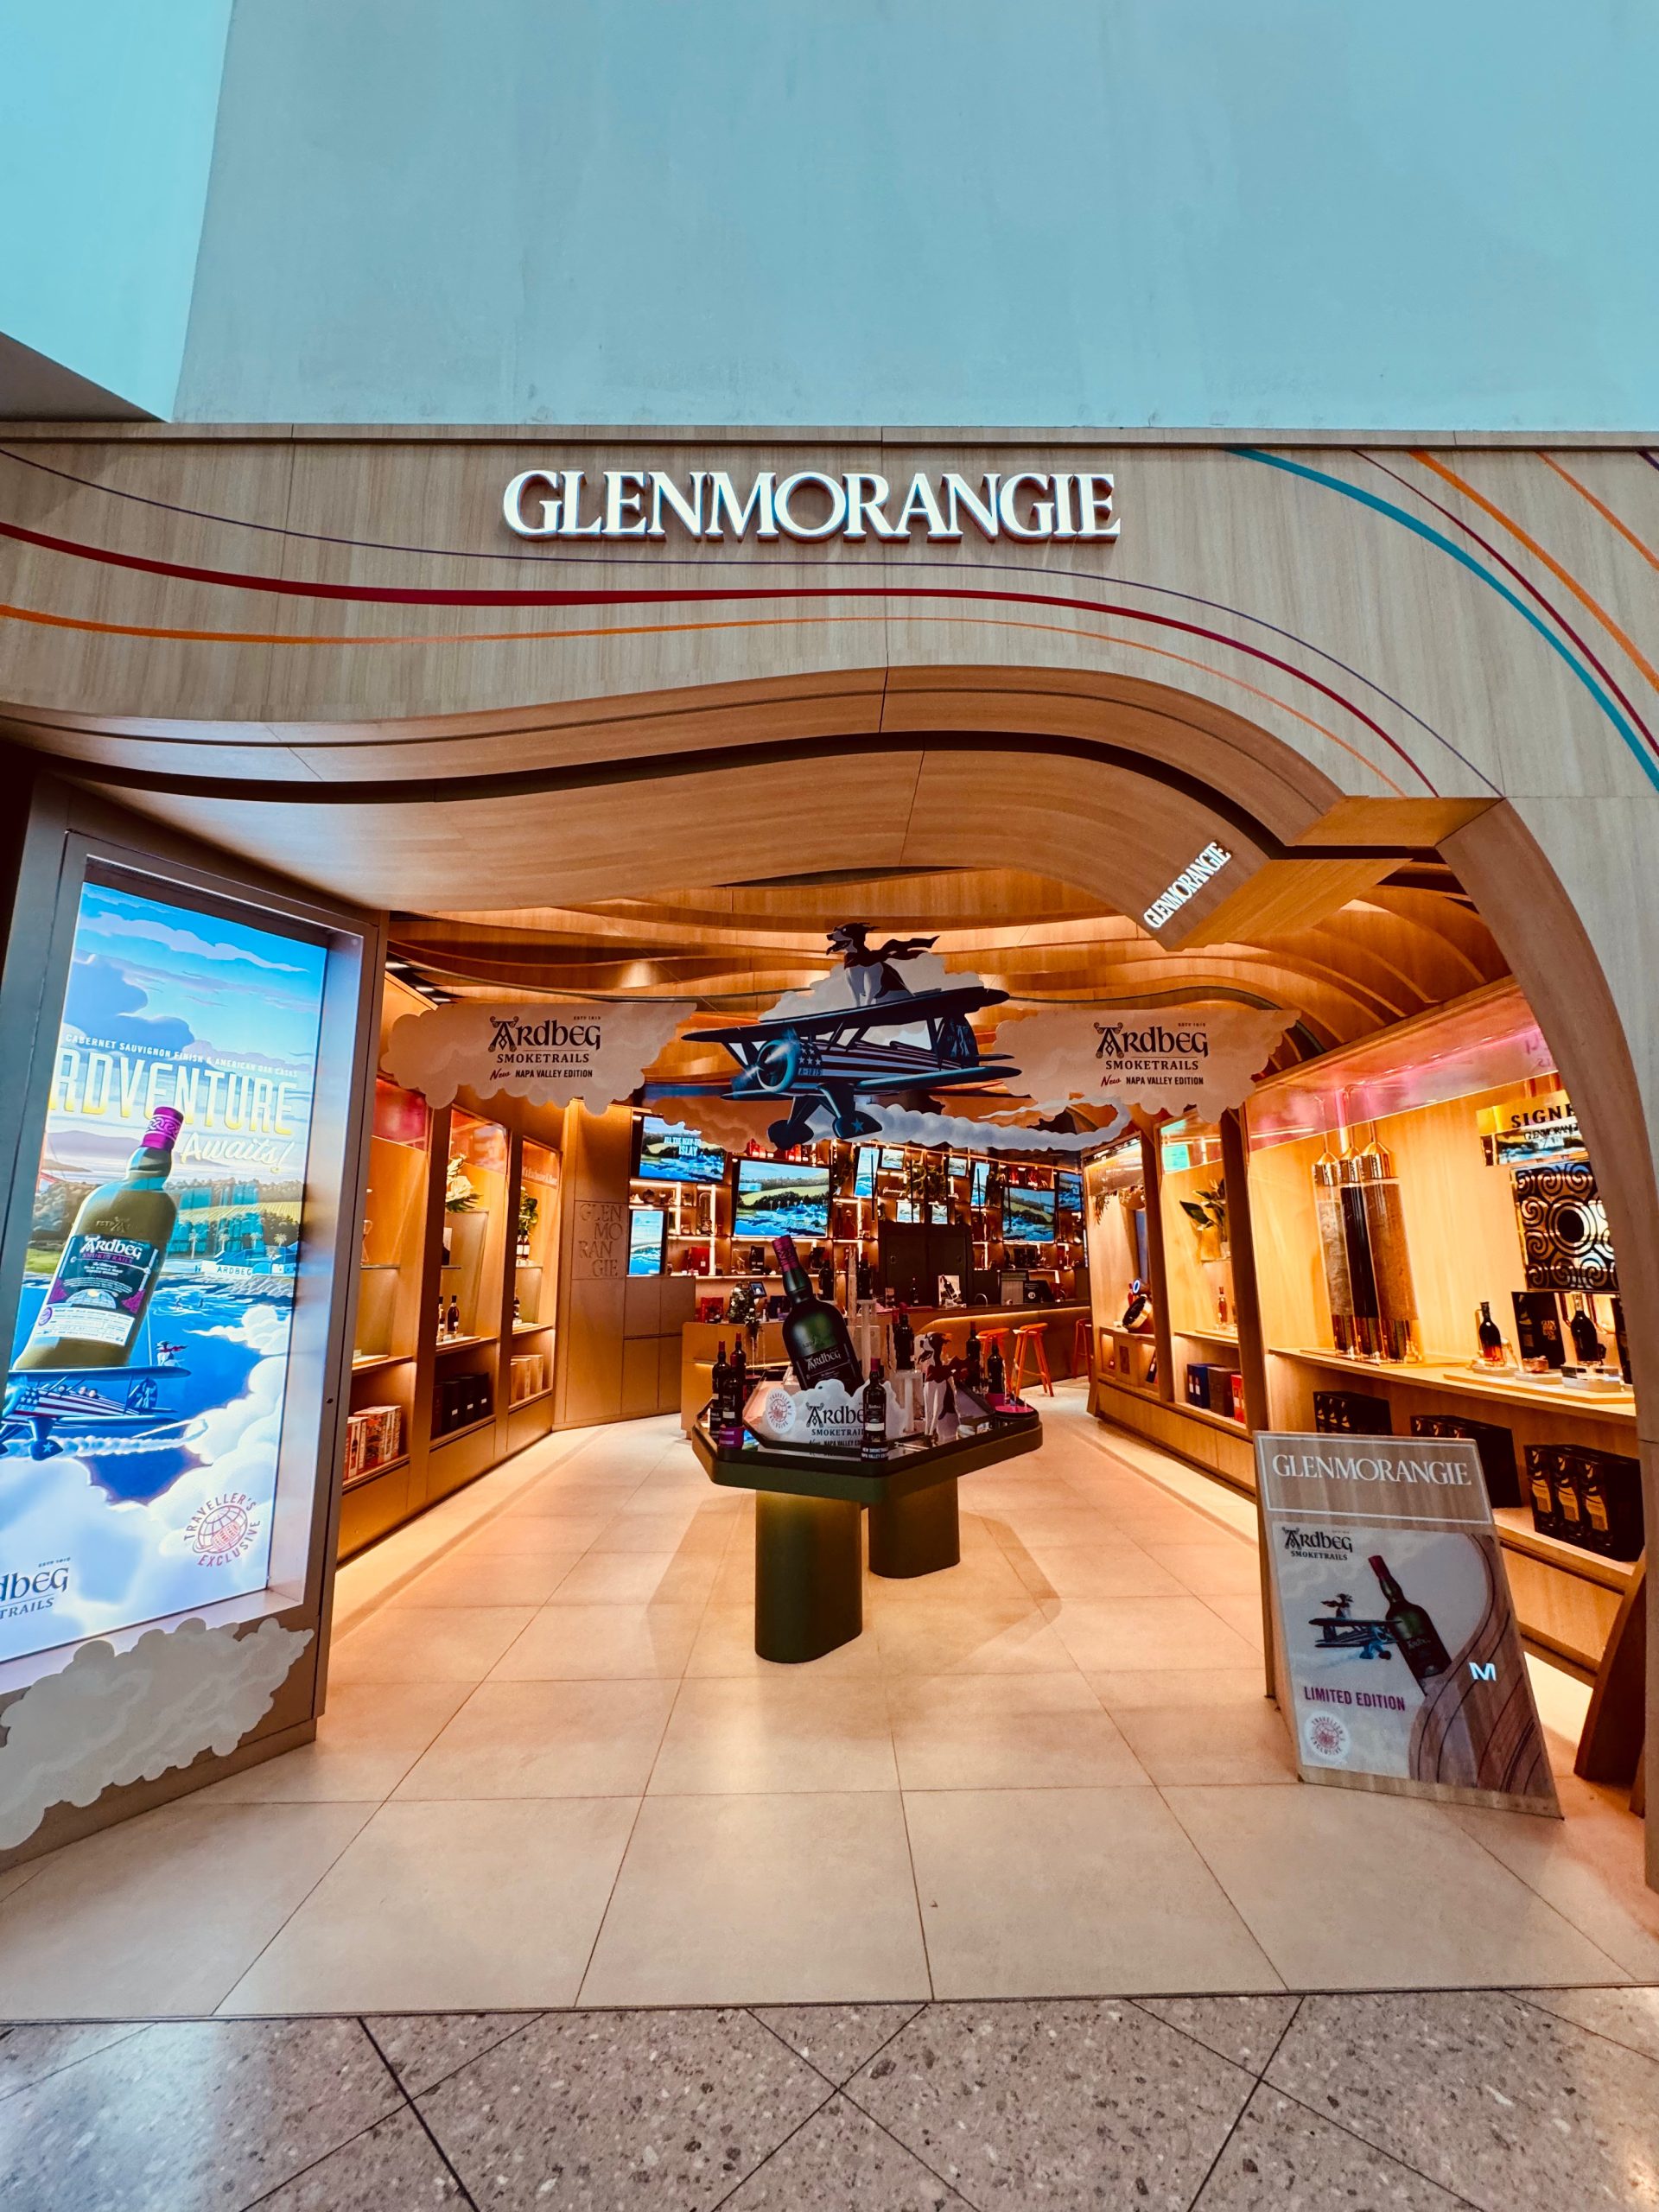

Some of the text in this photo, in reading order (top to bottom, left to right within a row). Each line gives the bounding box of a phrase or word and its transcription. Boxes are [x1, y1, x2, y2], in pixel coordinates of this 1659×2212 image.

[503, 470, 1122, 543] GLENMORANGIE
[1143, 841, 1232, 929] GLENMORANGIE
[65, 1033, 117, 1050] CABERNET
[119, 1042, 172, 1058] SAUVIGNON
[174, 1051, 204, 1064] FINISH
[215, 1058, 257, 1072] AMERICAN
[497, 1053, 590, 1064] SMOKETRAILS
[489, 1068, 593, 1080] New NAPA VALLEY EDITION
[1105, 1060, 1199, 1071] SMOKETRAILS
[48, 1047, 298, 1135] RDVENTURE
[1100, 1074, 1204, 1087] New NAPA VALLEY EDITION
[1510, 1103, 1576, 1128] SIGNE
[180, 1132, 296, 1174] Awaits!
[678, 1146, 698, 1156] ISLAY
[579, 1203, 623, 1222] GLEN
[594, 1223, 622, 1241] MO
[578, 1240, 613, 1259] RAN
[216, 1266, 252, 1276] ARDBEG
[591, 1259, 619, 1277] GIE
[805, 1402, 863, 1428] Ardbe
[811, 1428, 863, 1437] SMOKETRAI
[1272, 1454, 1471, 1485] GLENMORANGIE
[184, 1493, 257, 1541] TRAVELLER'S
[197, 1520, 261, 1567] EXCLUSIVE
[1290, 1550, 1348, 1560] SMOKETRAILS
[0, 1567, 69, 1601] dbeg
[0, 1597, 54, 1620] TRAILS
[1304, 1687, 1406, 1711] LIMITED EDITION
